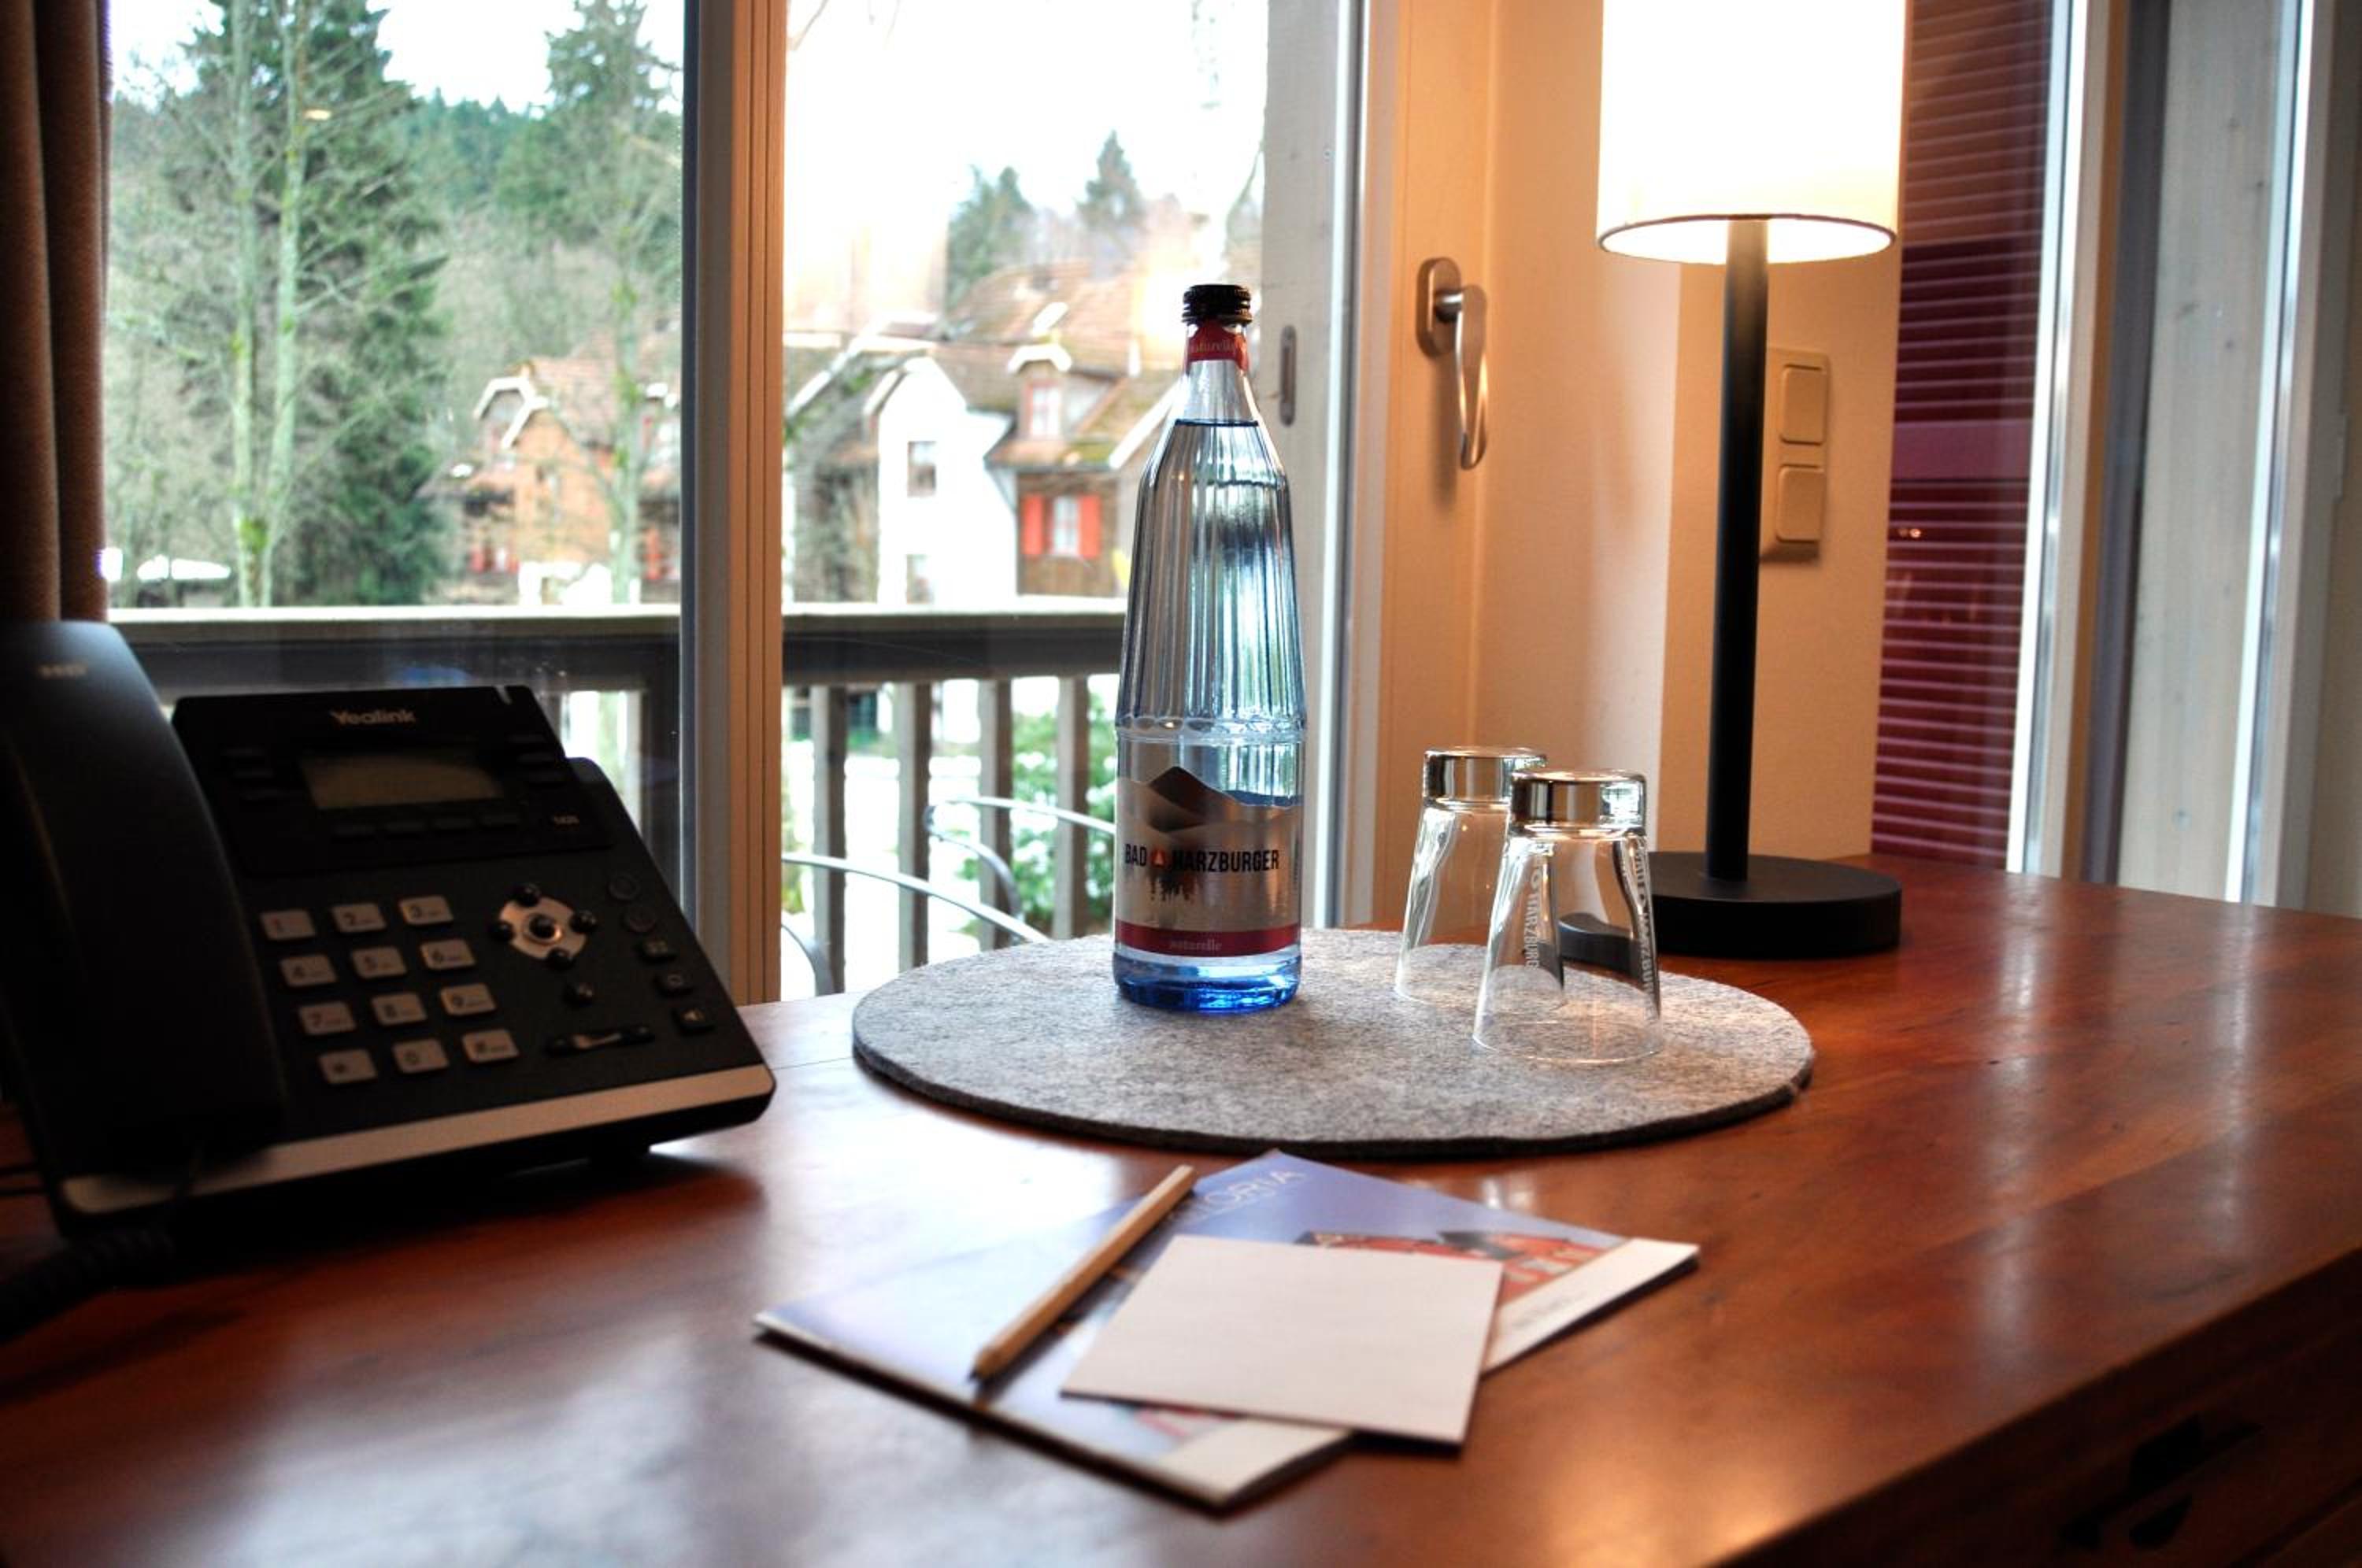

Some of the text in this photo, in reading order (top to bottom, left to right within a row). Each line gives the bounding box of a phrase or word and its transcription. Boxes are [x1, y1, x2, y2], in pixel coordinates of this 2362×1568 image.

[328, 708, 416, 724] Yealink
[1124, 843, 1147, 867] BAD
[1172, 849, 1279, 873] HARZBURGER
